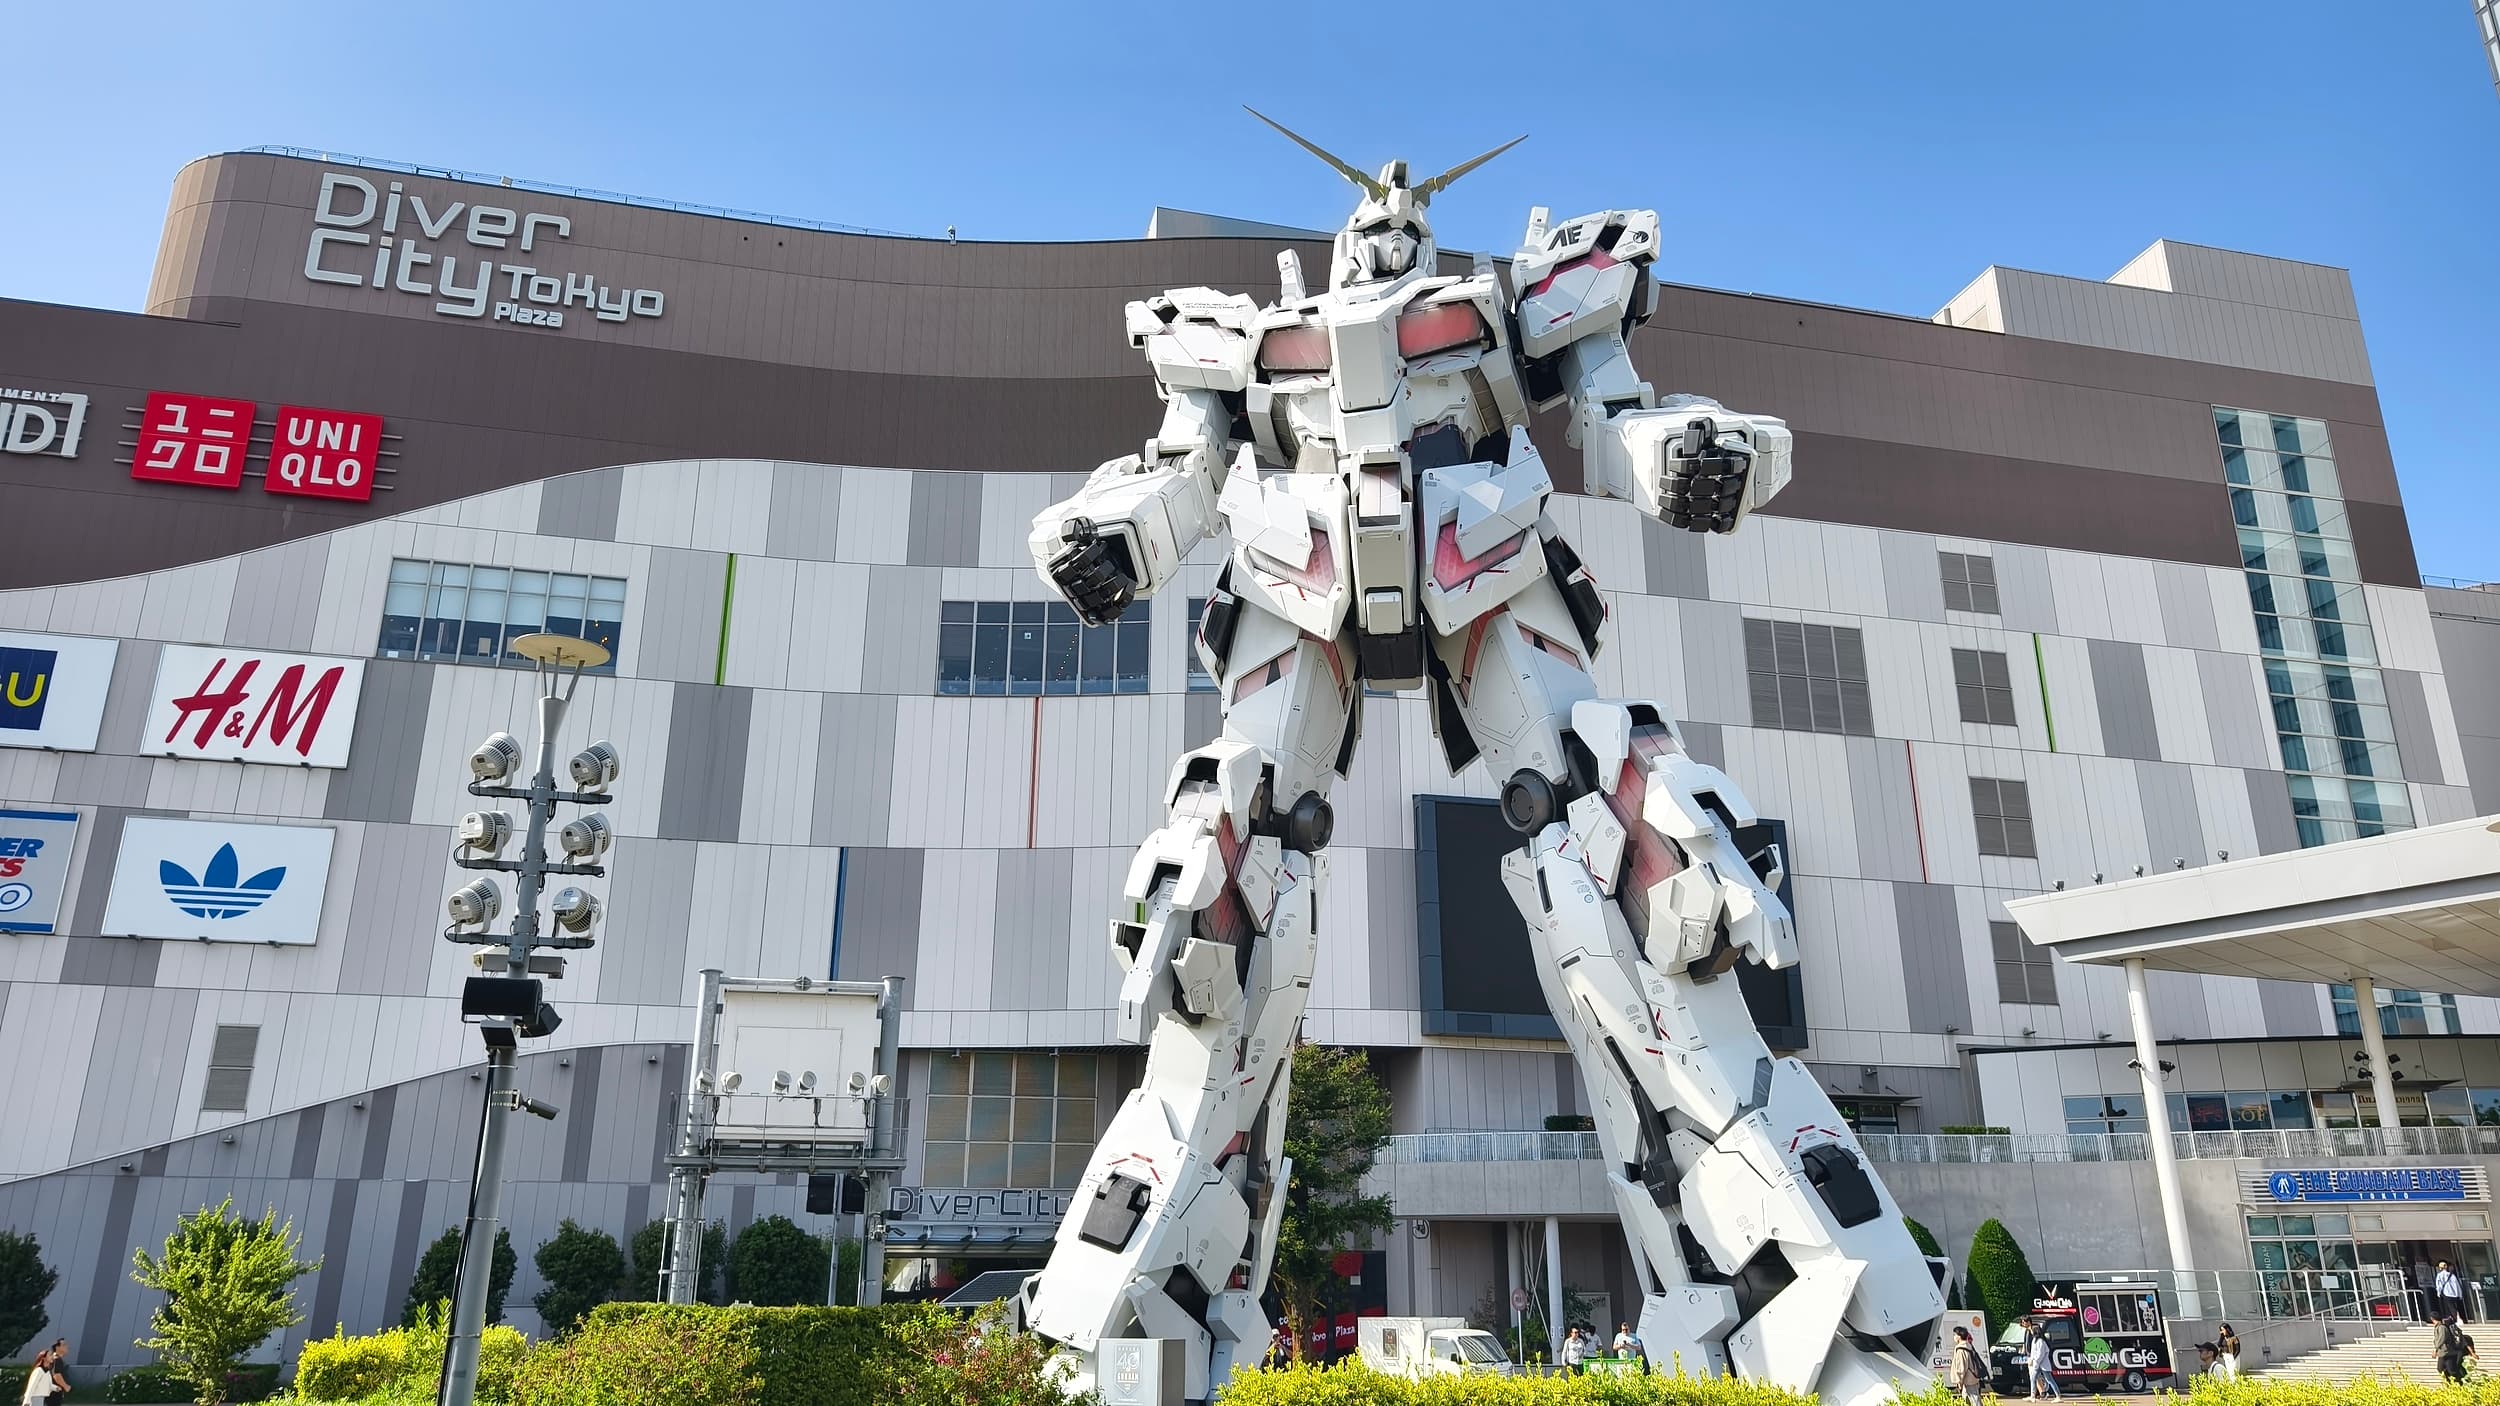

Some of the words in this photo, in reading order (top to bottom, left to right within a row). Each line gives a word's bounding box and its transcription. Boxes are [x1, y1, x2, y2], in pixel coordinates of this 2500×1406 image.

[314, 172, 570, 252] Diver
[304, 228, 491, 318] City
[494, 302, 563, 328] Plaza
[0, 388, 60, 403] MENT
[157, 404, 235, 438] ユニ
[287, 416, 362, 452] UNI
[146, 440, 230, 474] クロ
[280, 452, 362, 488] QLO
[0, 672, 46, 707] U
[165, 657, 345, 757] H&M
[0, 837, 44, 858] ER
[2300, 1170, 2333, 1192] THE
[2337, 1168, 2415, 1192] GUNDAM
[2419, 1168, 2465, 1190] BASE
[2052, 1349, 2118, 1369] GUNDAM
